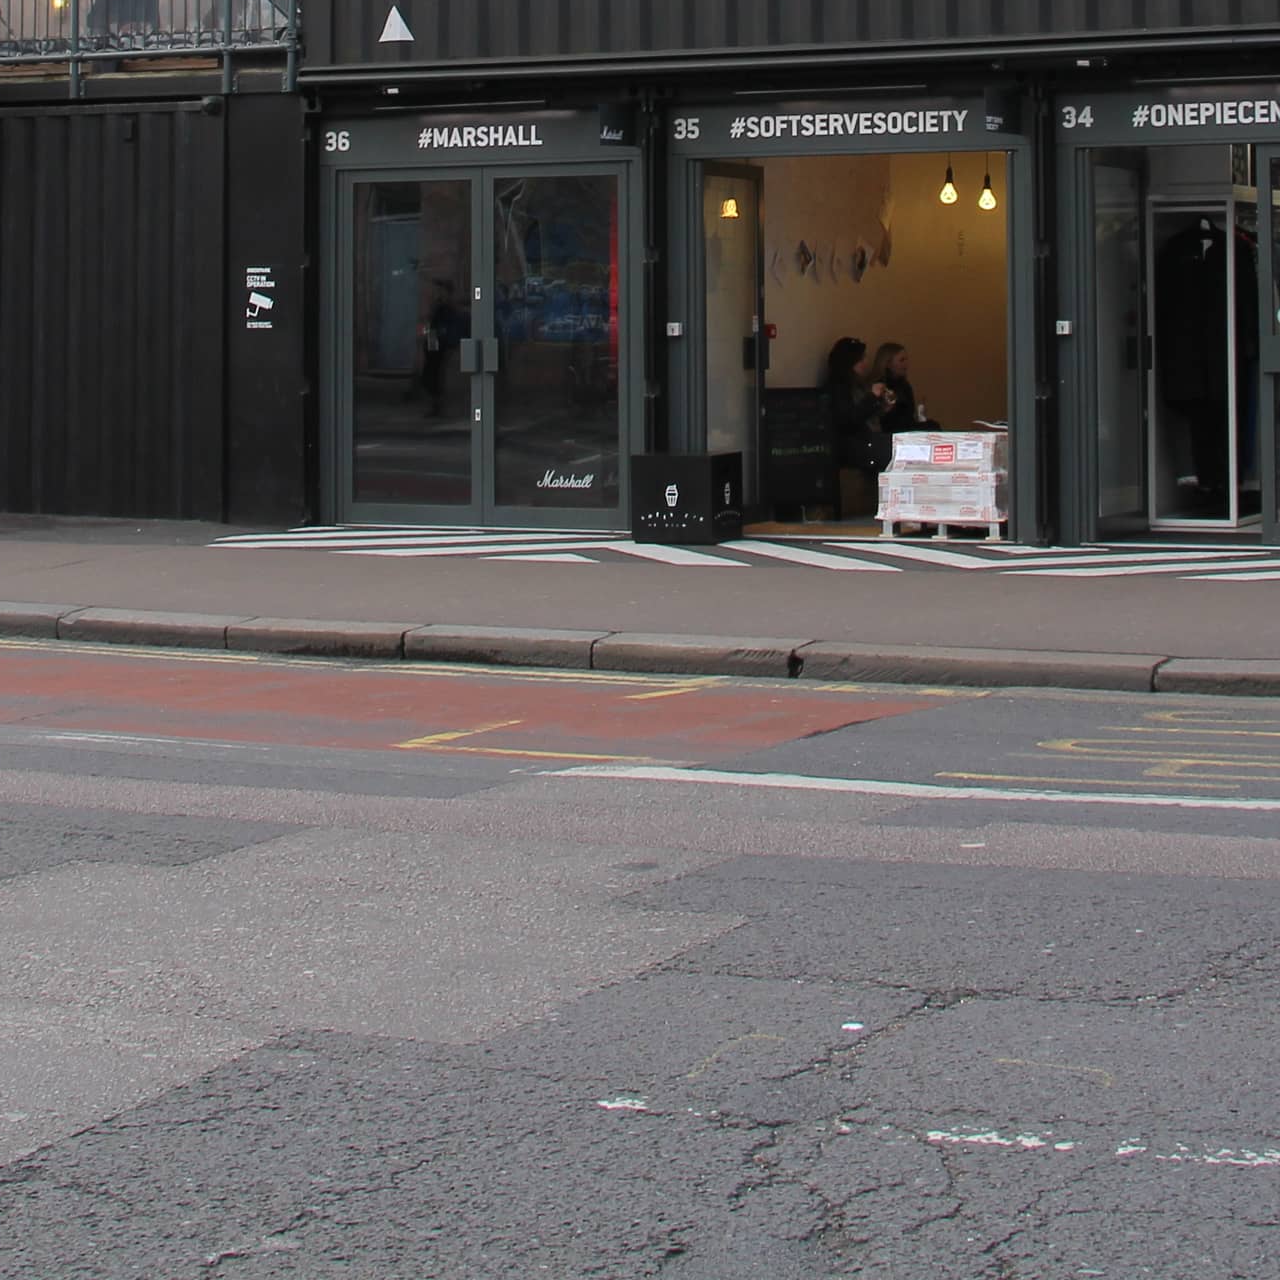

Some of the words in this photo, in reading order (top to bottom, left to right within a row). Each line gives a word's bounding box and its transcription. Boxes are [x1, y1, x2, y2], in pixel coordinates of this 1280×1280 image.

[730, 110, 968, 138] #SOFTSERVESOCIETY
[1062, 106, 1094, 128] 34
[418, 125, 543, 148] #MARSHALL
[674, 118, 700, 139] 35
[325, 131, 350, 151] 36
[536, 470, 594, 488] Marshall
